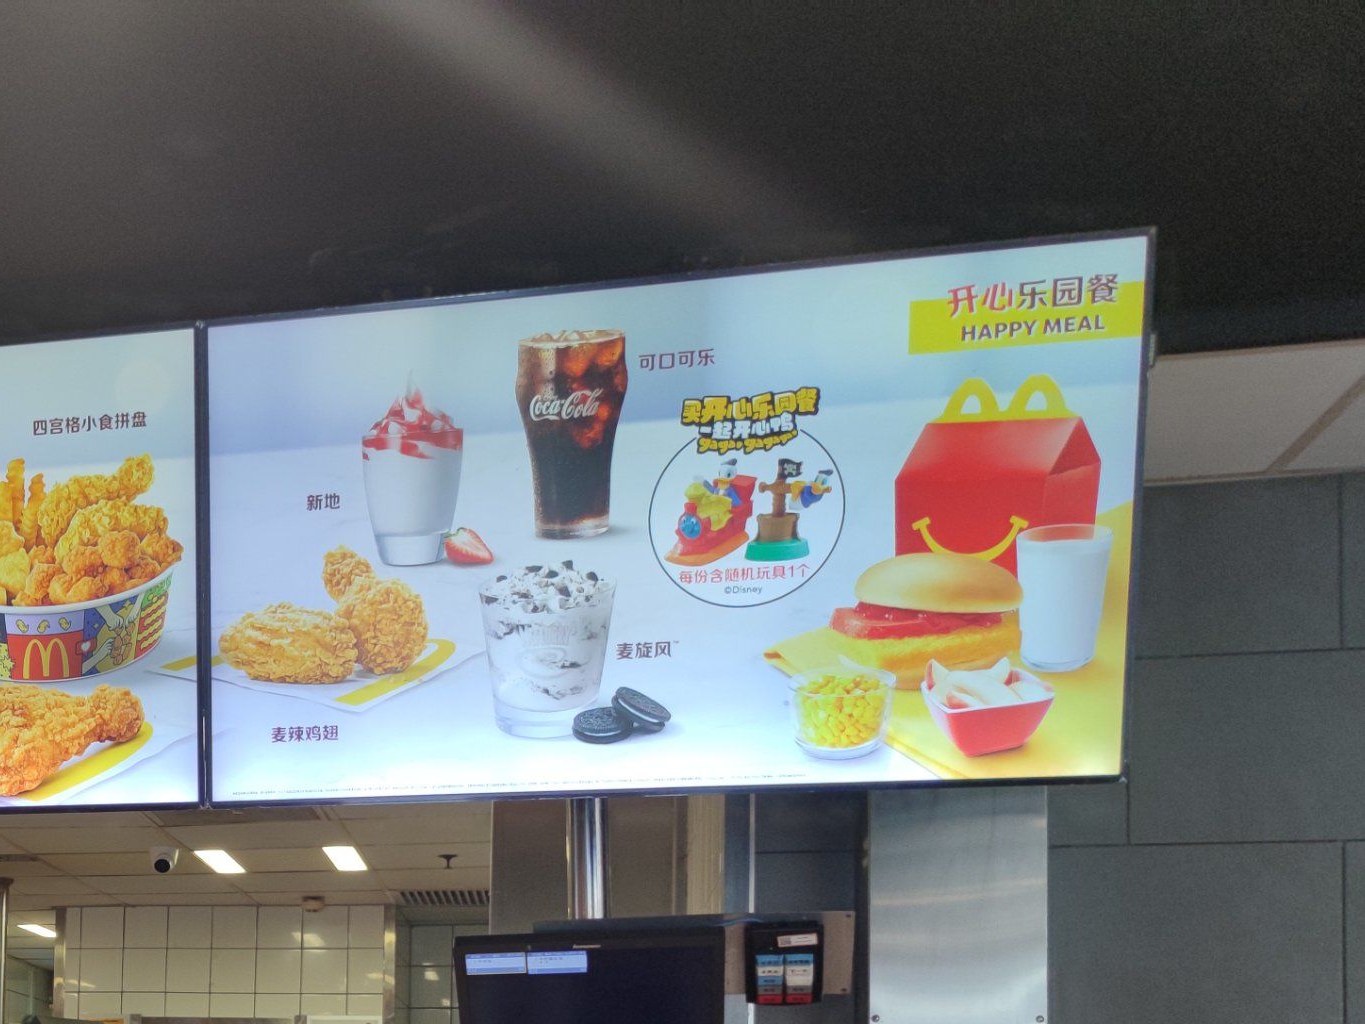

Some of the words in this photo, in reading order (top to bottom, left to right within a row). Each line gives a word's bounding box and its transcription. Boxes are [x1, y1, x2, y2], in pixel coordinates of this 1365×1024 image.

[947, 273, 1118, 317] 开心乐园餐
[961, 319, 1037, 341] HAPPY
[1042, 314, 1105, 334] MEAL
[639, 348, 714, 372] 可口可乐
[529, 388, 603, 421] Coca-Cola
[32, 411, 147, 436] 四宫格小食拼盘
[306, 493, 340, 512] 新地
[678, 564, 809, 584] 每份含随机玩具1个
[616, 640, 672, 660] 麦旋风
[271, 724, 339, 743] 麦辣鸡翅
